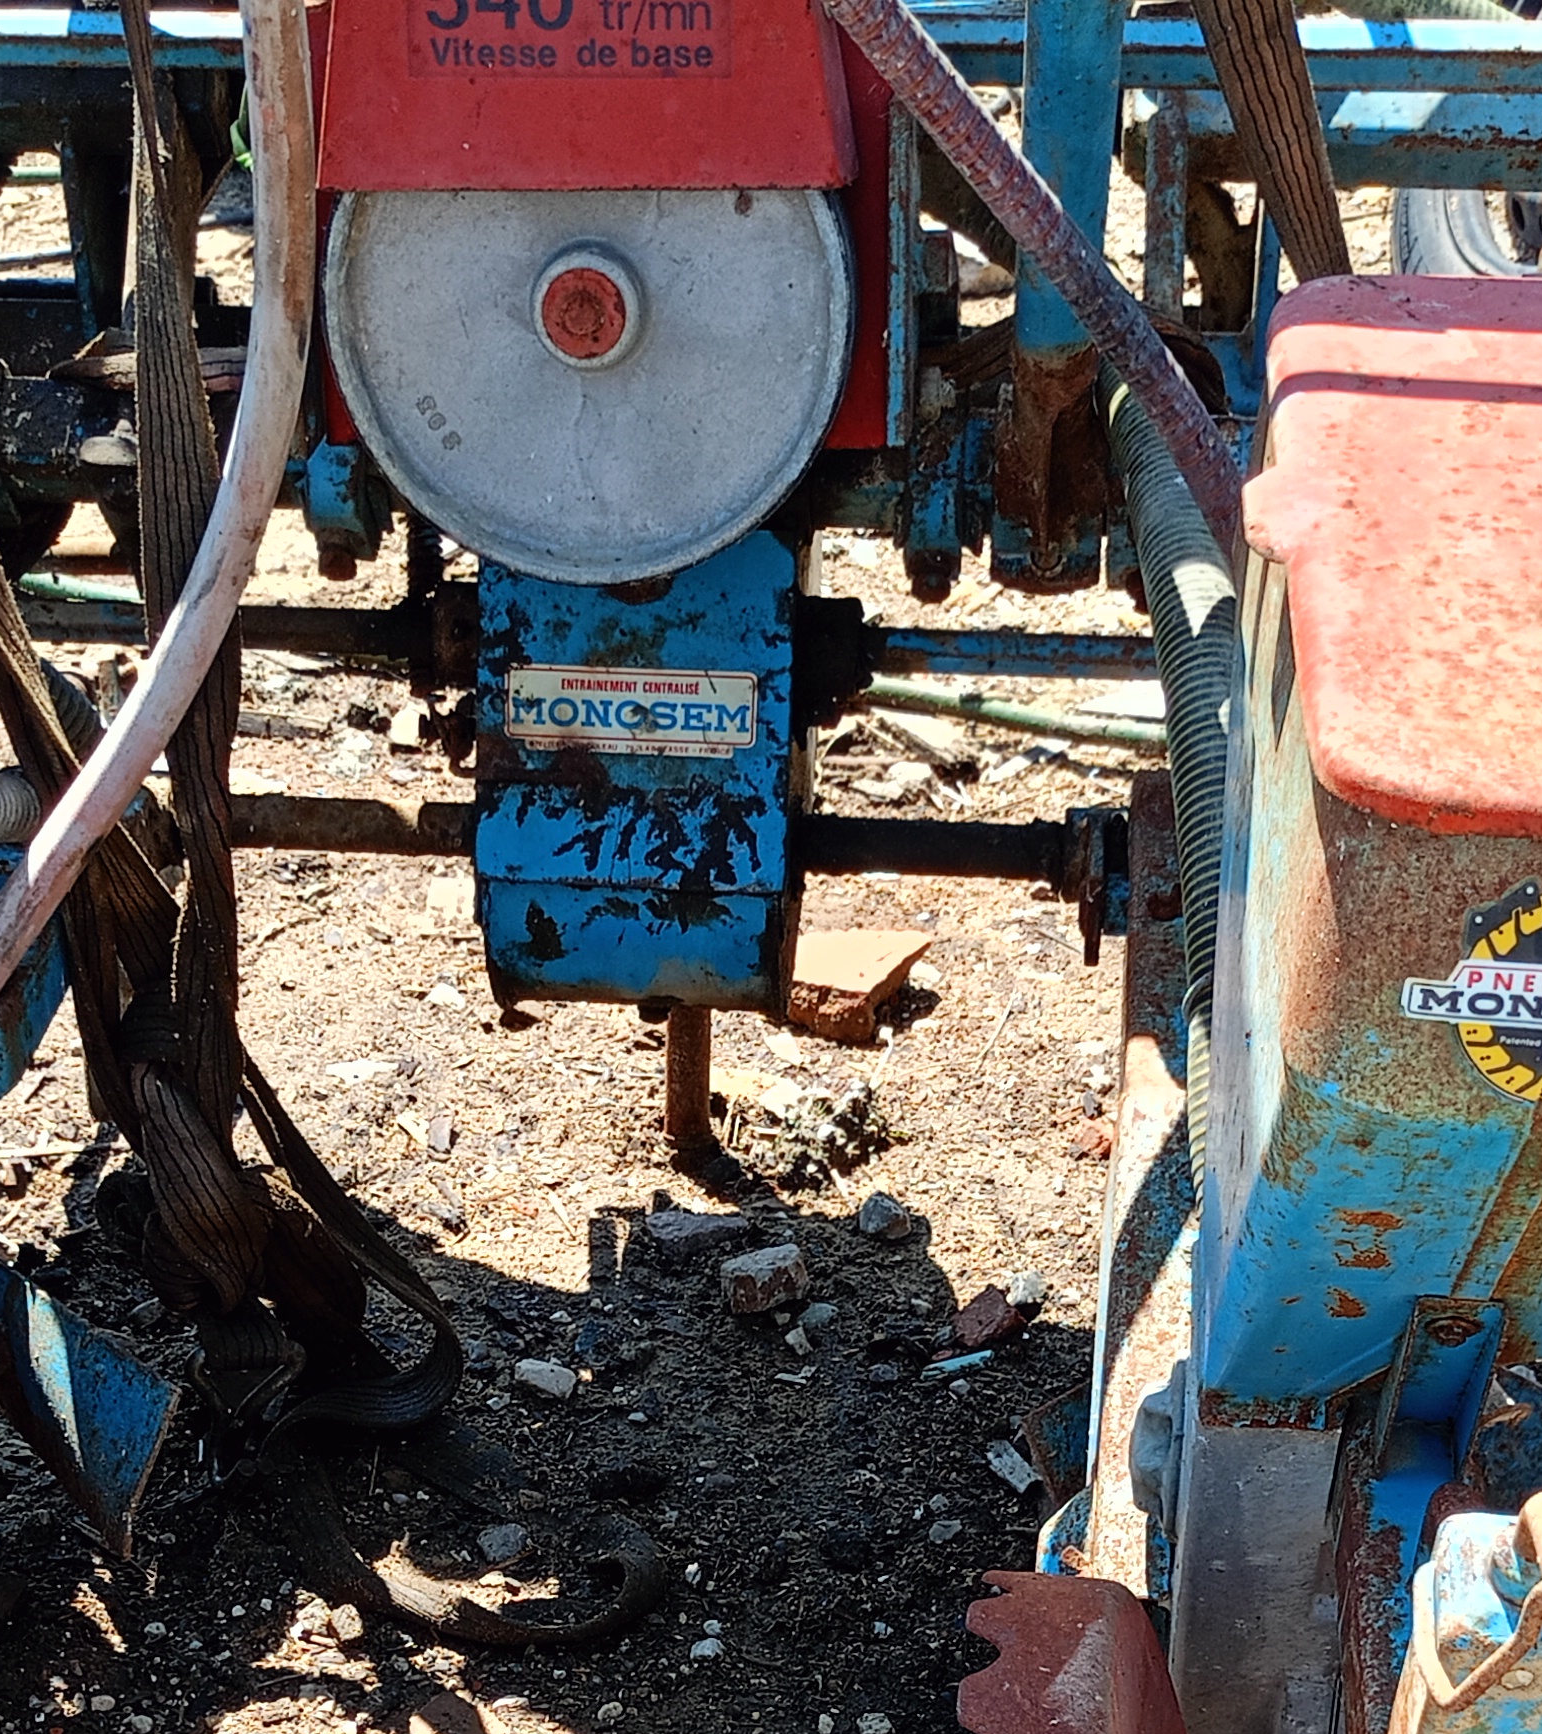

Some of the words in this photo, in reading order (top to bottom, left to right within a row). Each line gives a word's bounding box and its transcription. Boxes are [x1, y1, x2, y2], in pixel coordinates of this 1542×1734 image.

[599, 0, 713, 35] tr/mn
[430, 38, 557, 68] Vitesse
[576, 38, 618, 68] de
[630, 38, 714, 68] base
[561, 678, 638, 693] ENTRAINEMENT
[642, 681, 700, 695] CENTRALISÉ
[511, 696, 750, 733] MONOSEM
[1499, 1035, 1542, 1048] Patented
